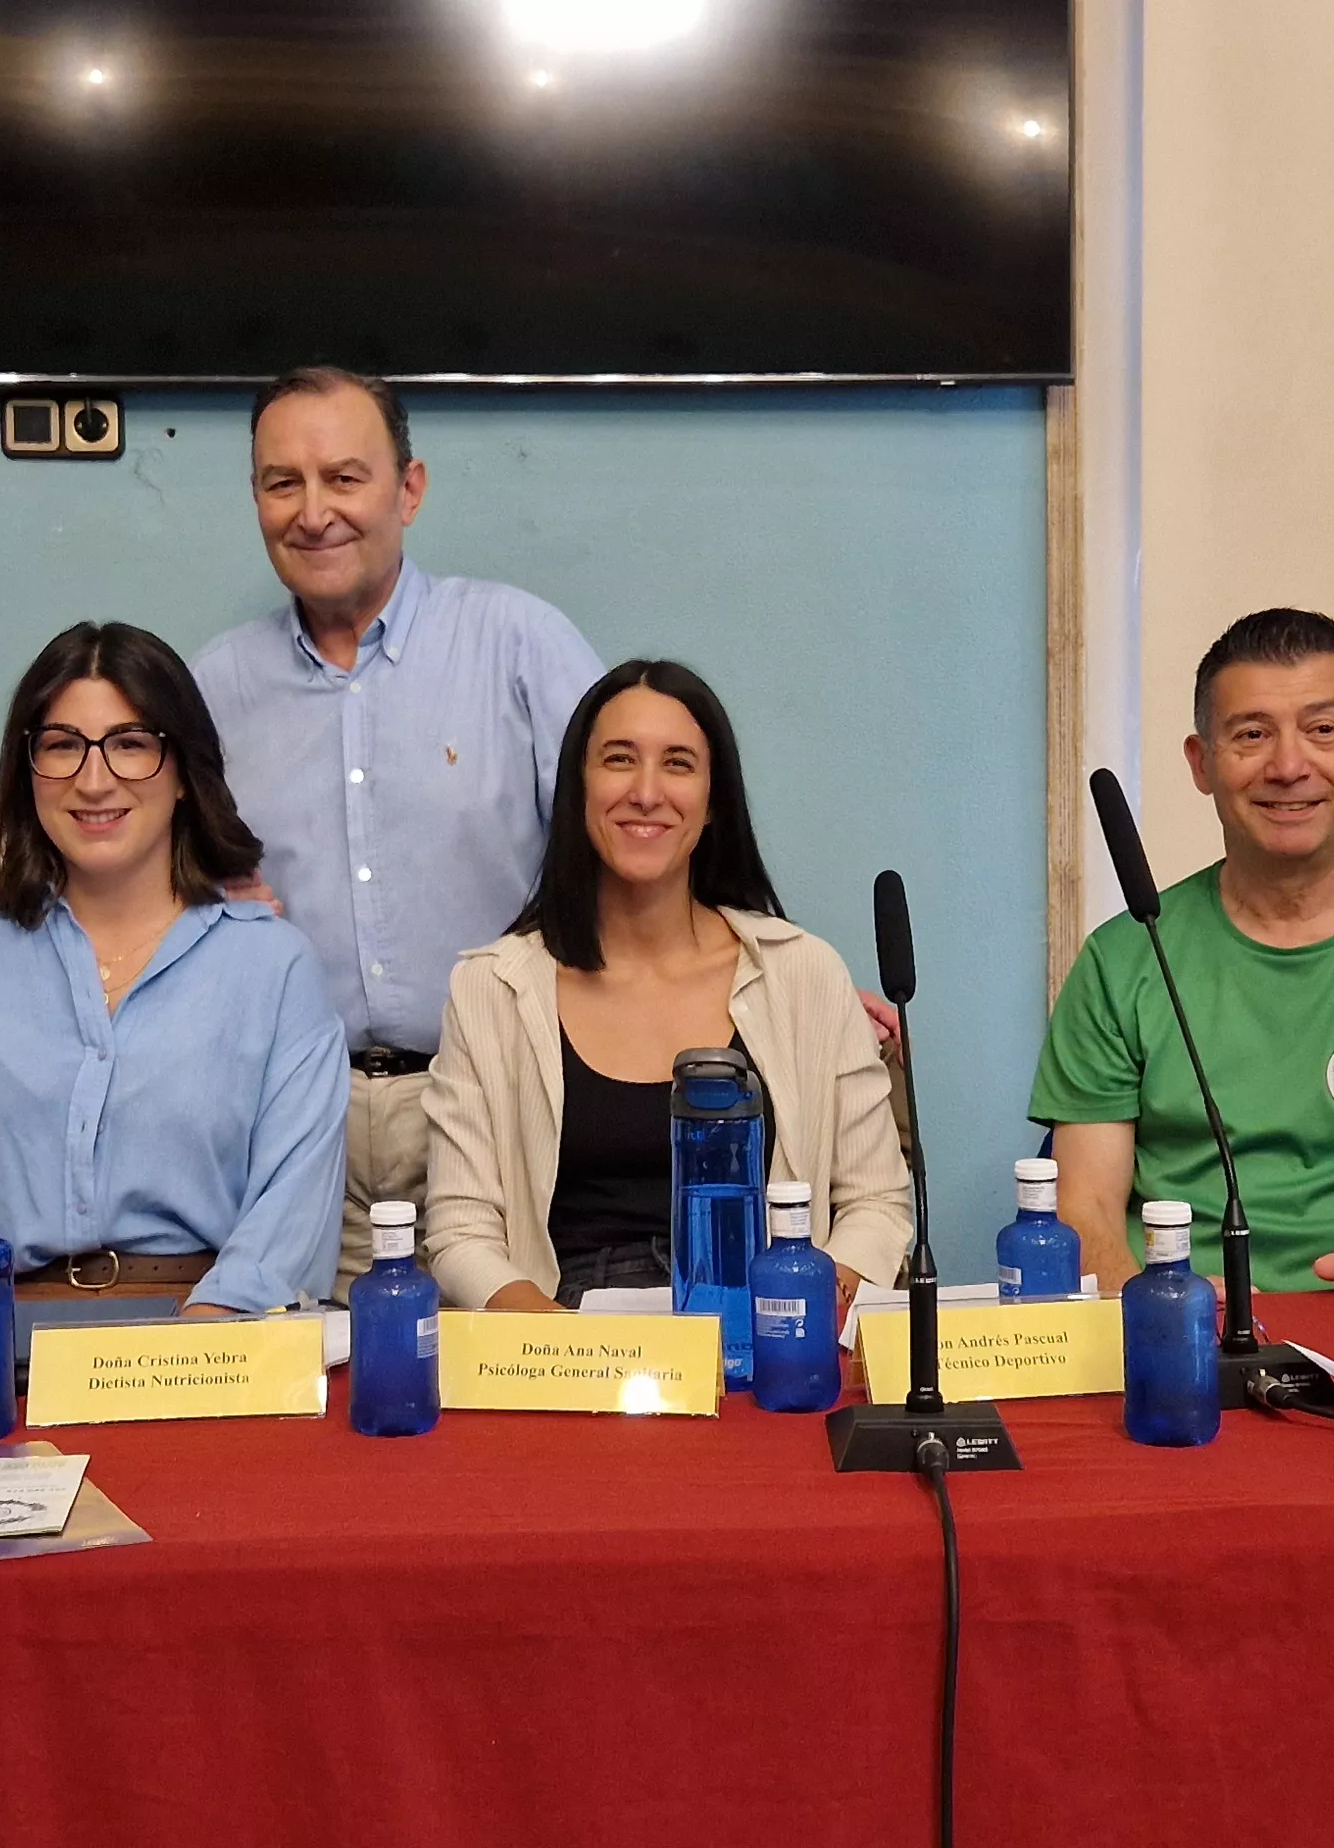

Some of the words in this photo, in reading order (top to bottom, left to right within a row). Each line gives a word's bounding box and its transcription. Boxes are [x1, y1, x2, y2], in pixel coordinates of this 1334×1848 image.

[957, 1334, 1009, 1349] Andrés
[1014, 1331, 1068, 1346] Pascual
[521, 1342, 560, 1356] Doña
[563, 1344, 593, 1357] Ana
[599, 1344, 642, 1358] Naval
[92, 1355, 132, 1369] Doña
[137, 1353, 199, 1368] Cristina
[203, 1351, 247, 1365] Yebra
[994, 1353, 1066, 1370] Deportivo
[478, 1362, 546, 1380] Psicóloga
[550, 1364, 609, 1379] General
[89, 1376, 146, 1390] Dietista
[150, 1372, 249, 1388] Nutricionista
